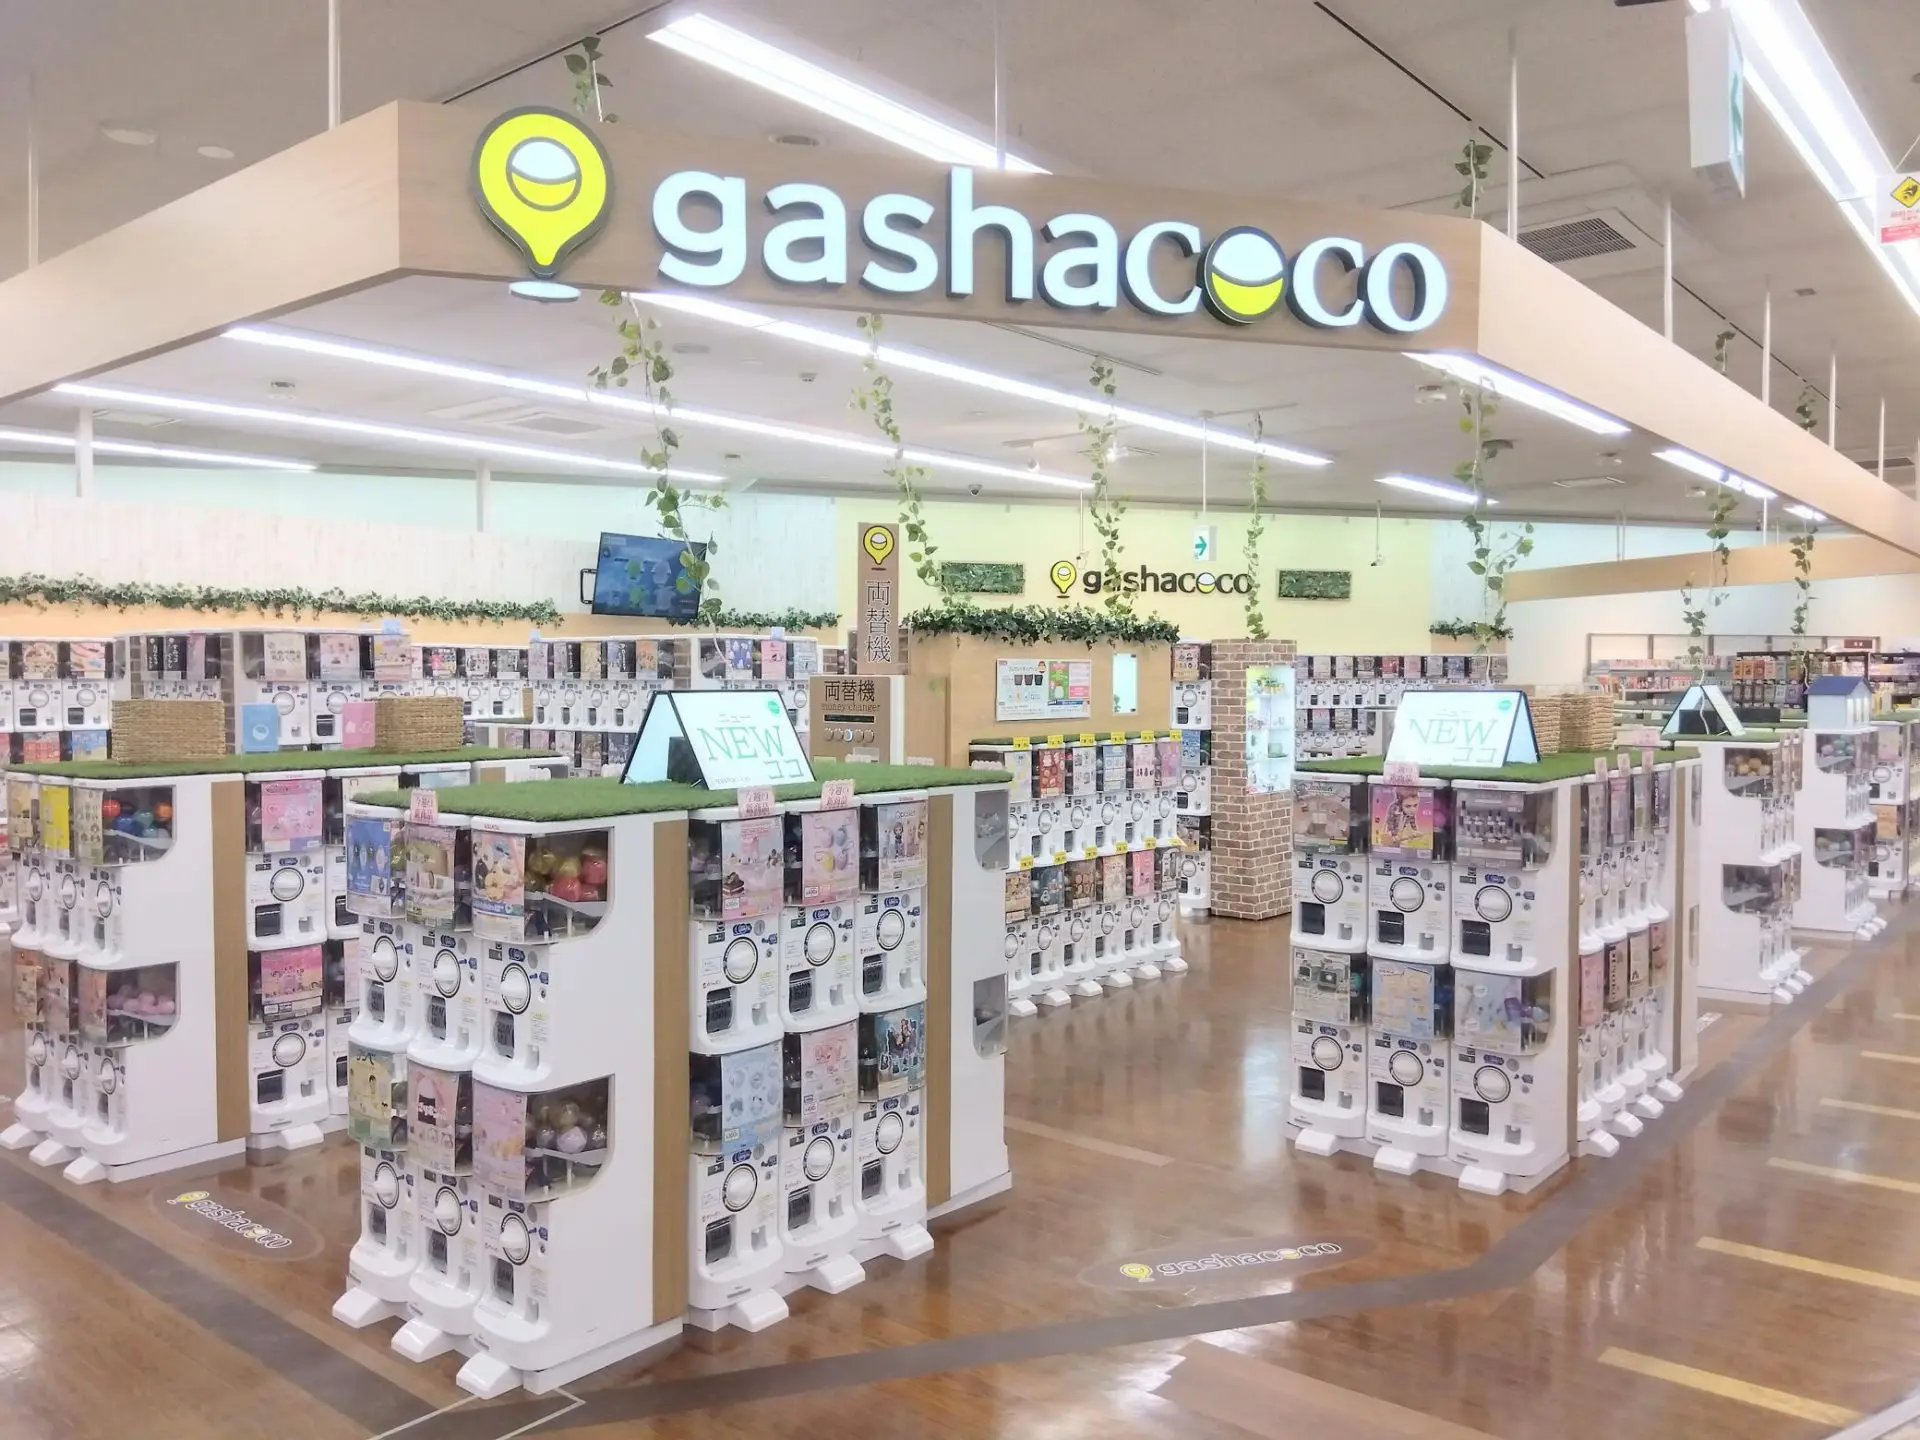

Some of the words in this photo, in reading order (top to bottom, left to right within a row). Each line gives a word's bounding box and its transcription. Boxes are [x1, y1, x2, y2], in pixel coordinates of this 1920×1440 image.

[651, 166, 1450, 335] gashacoco
[865, 579, 891, 664] 両替機
[824, 679, 875, 702] 両替機
[697, 724, 784, 762] NEW
[1408, 717, 1498, 745] NEW
[1156, 1242, 1342, 1276] gashacoco
